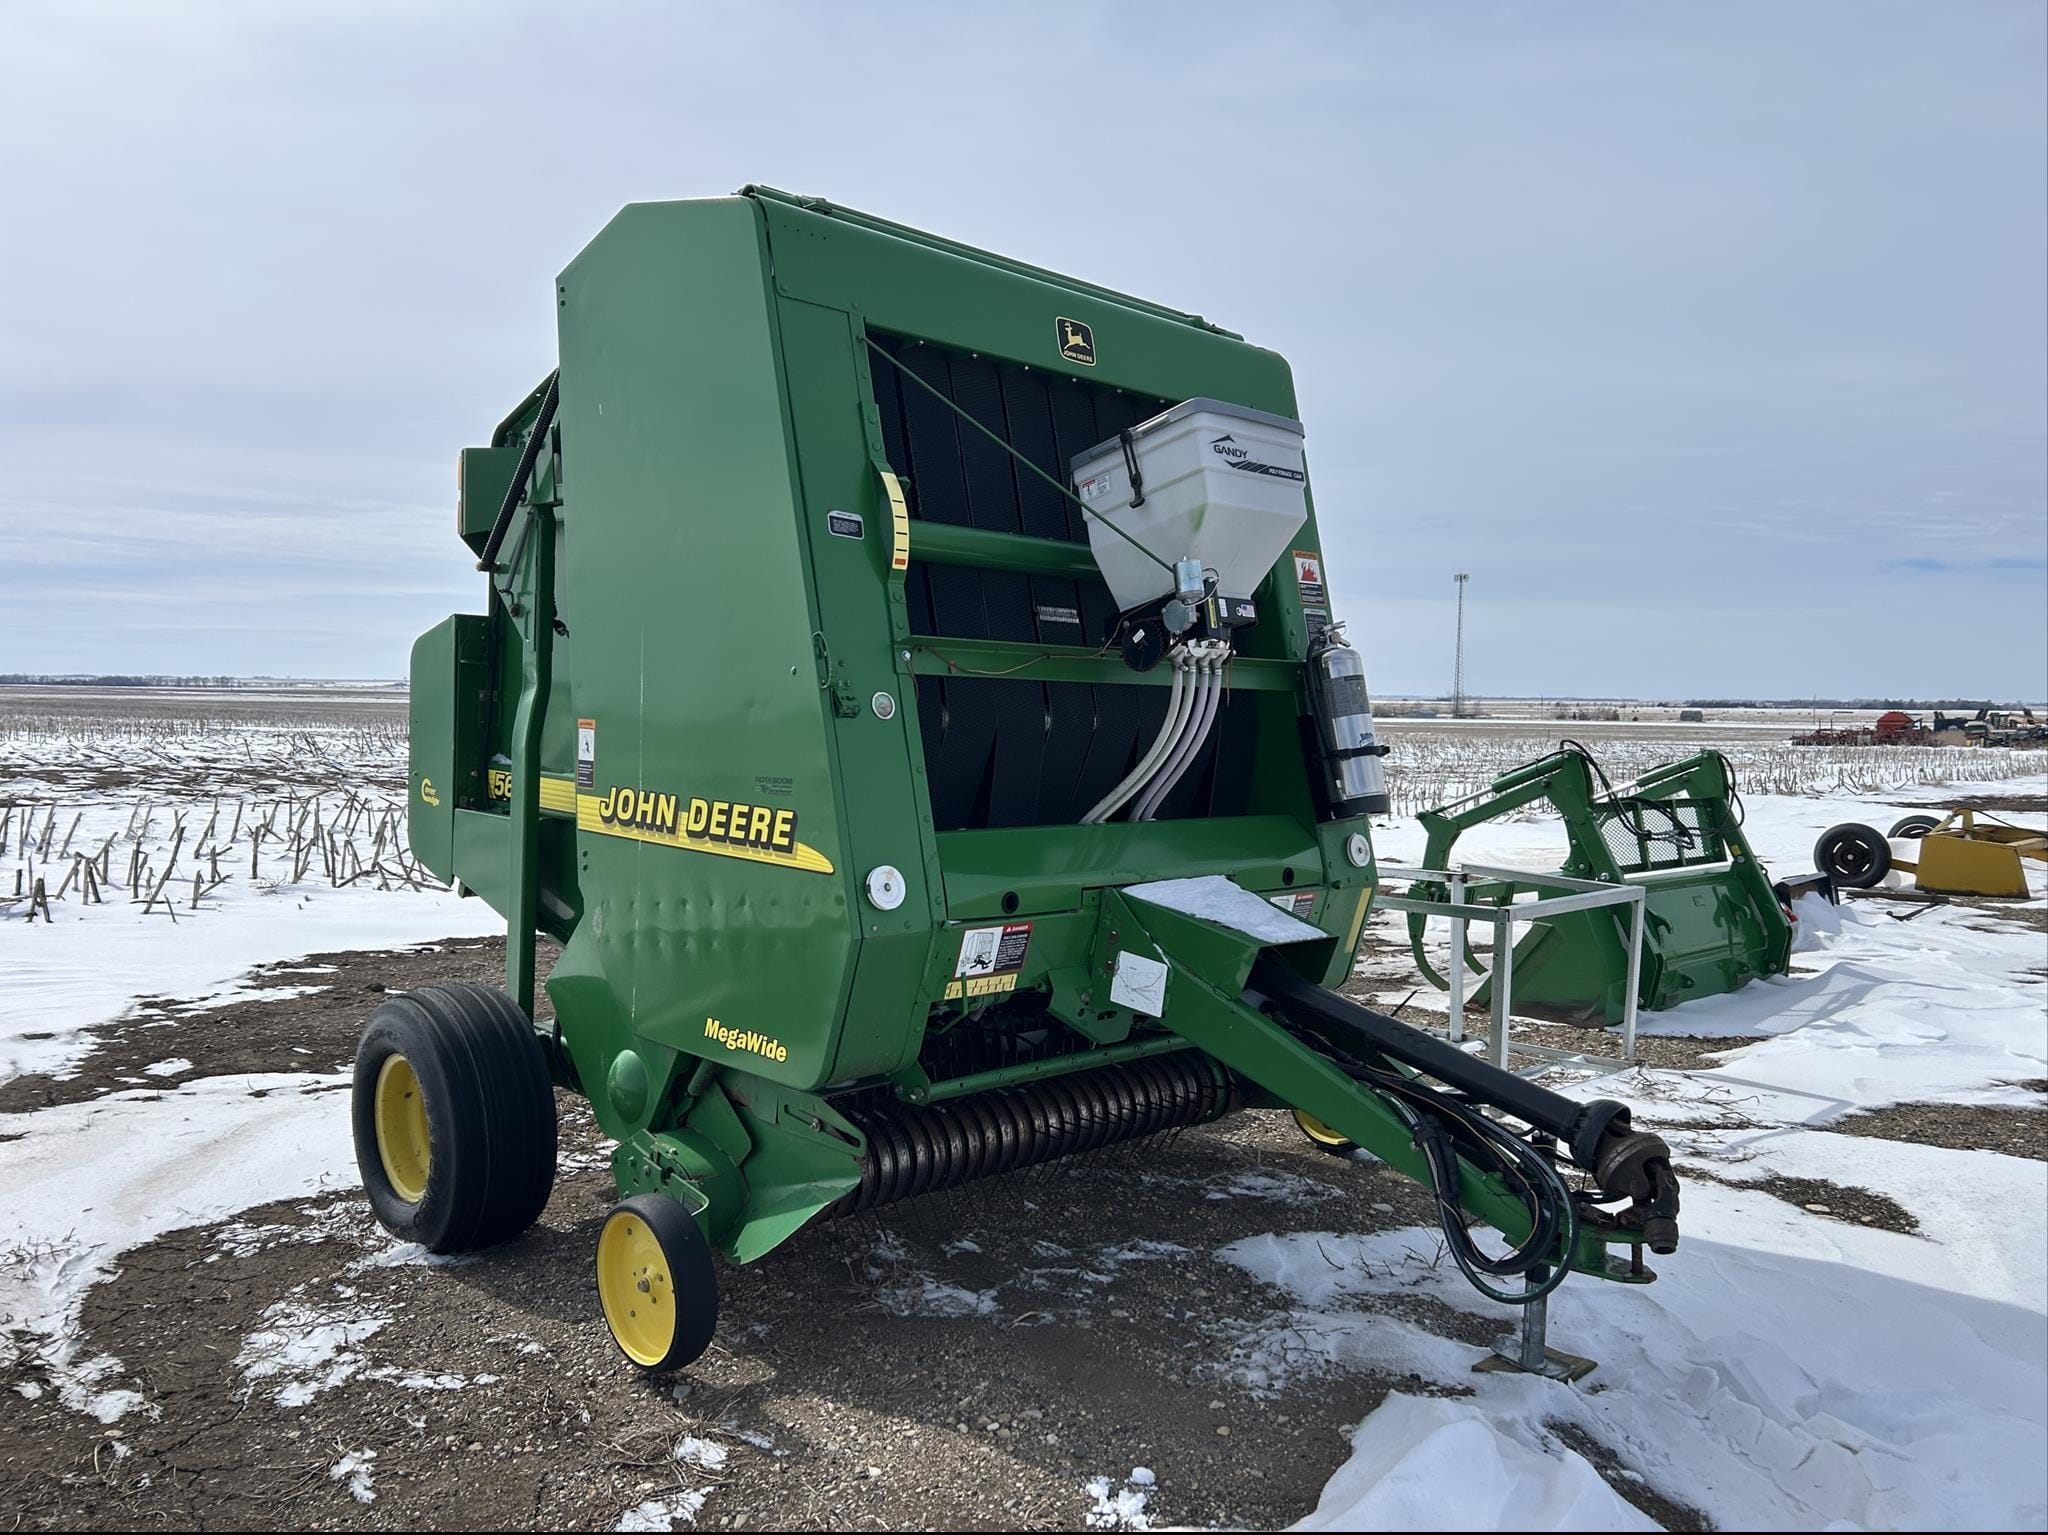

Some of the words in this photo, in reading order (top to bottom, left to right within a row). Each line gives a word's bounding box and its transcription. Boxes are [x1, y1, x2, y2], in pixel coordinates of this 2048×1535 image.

[1213, 444, 1248, 459] GANDY
[494, 772, 513, 799] 56
[599, 785, 678, 834] JOHN
[686, 796, 799, 855] DEERE
[704, 1017, 787, 1062] MegaWide
